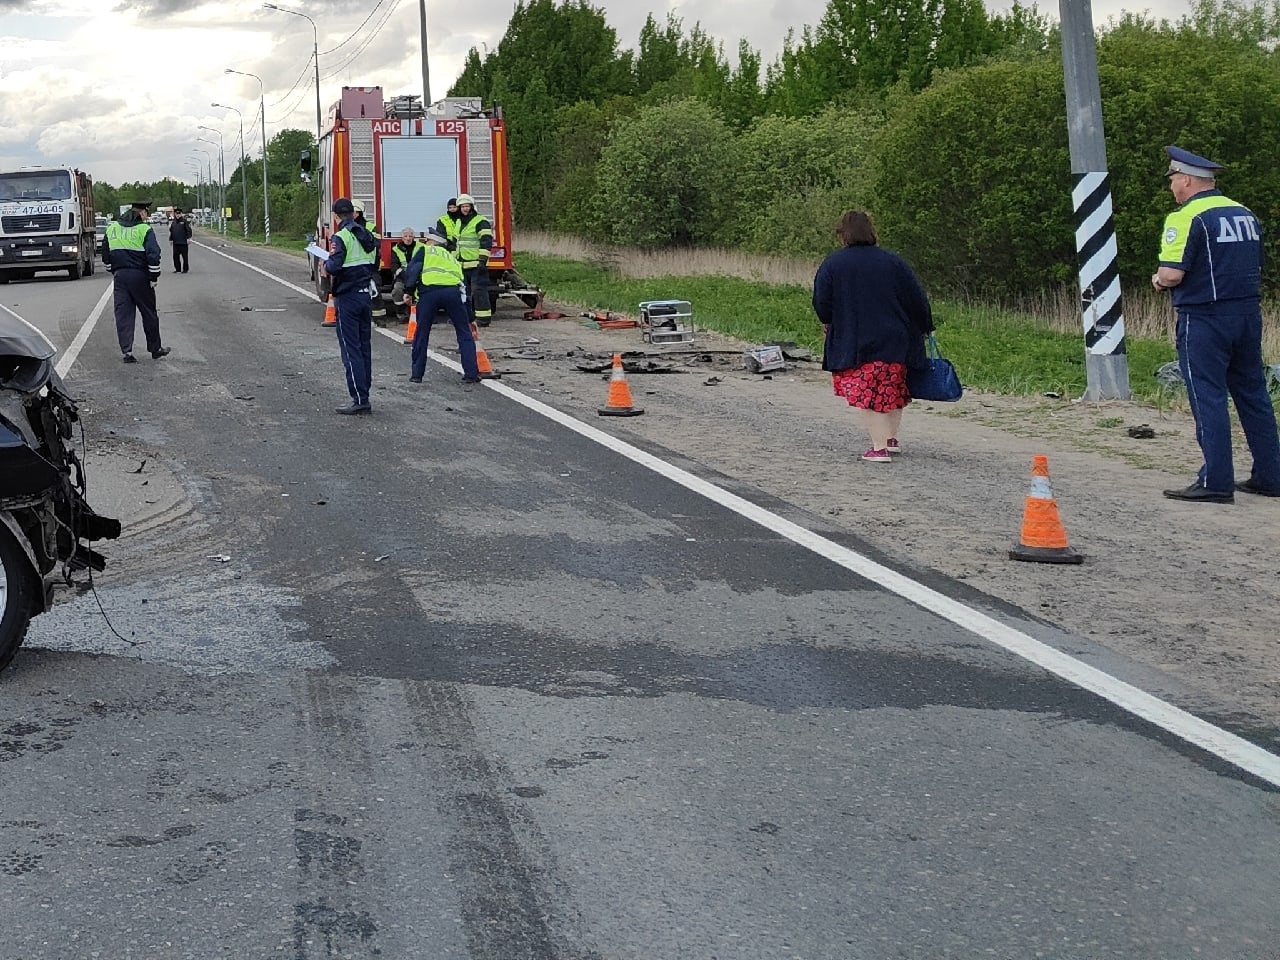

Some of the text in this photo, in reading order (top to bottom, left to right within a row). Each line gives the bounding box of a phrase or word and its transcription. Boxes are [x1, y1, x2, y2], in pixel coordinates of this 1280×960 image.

[373, 121, 401, 133] АПС
[438, 121, 465, 133] 125
[22, 205, 64, 215] 47-04-05
